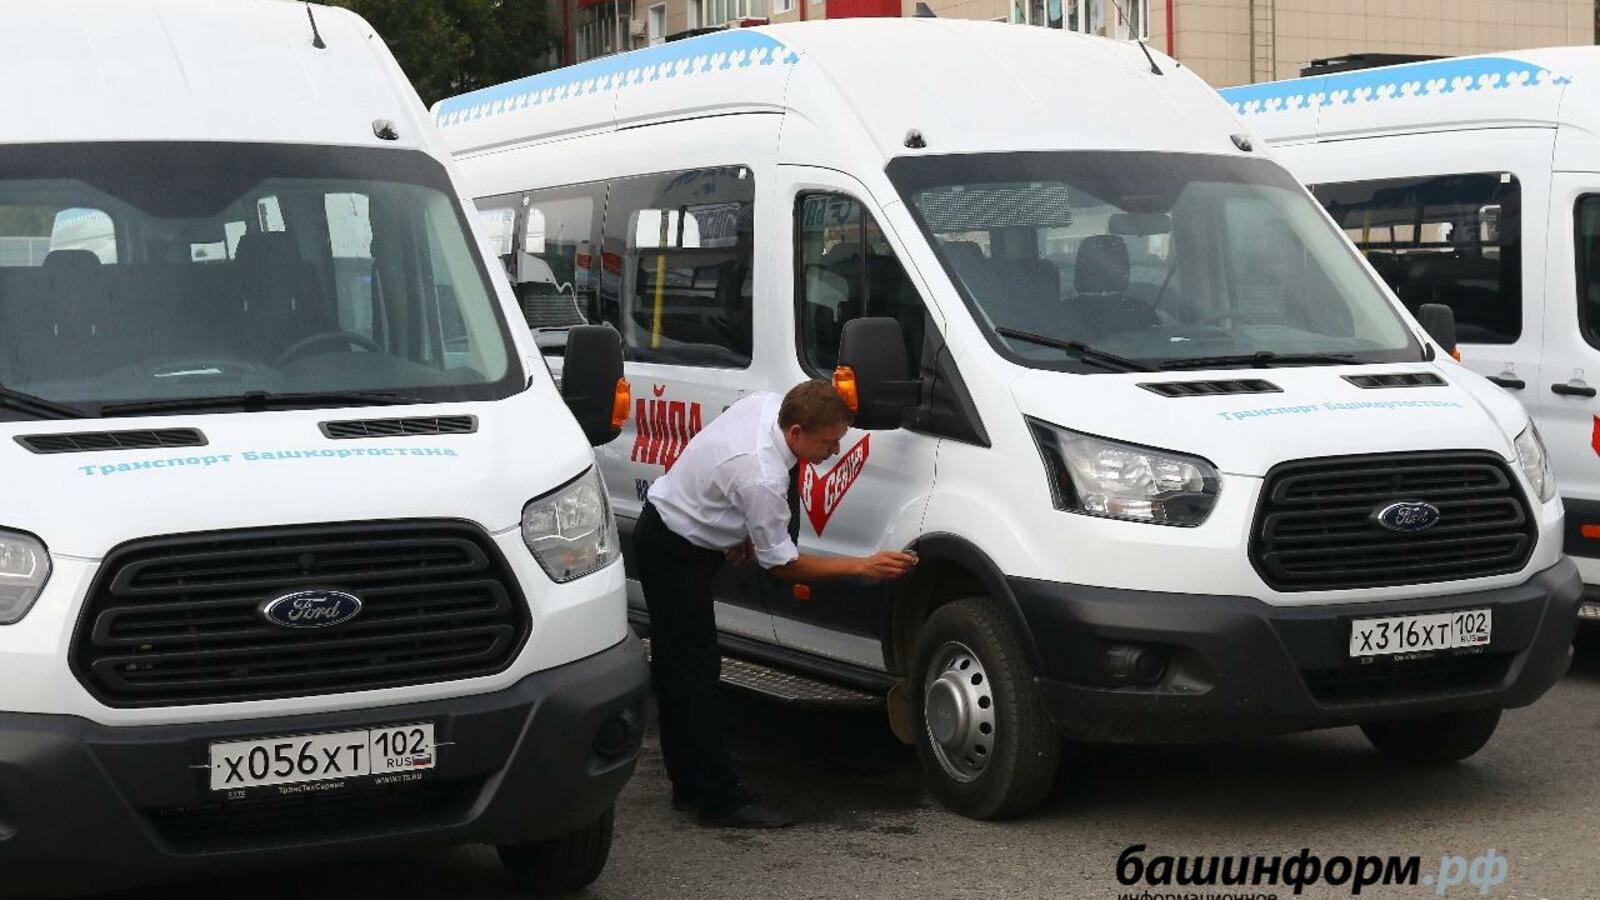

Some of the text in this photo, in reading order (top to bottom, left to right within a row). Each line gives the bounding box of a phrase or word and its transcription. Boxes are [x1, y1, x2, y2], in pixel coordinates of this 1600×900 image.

[1217, 403, 1319, 421] Транспорт
[78, 447, 459, 476] Транспорт Башкортостана
[288, 597, 341, 621] Ford
[1360, 612, 1486, 652] Х316ХТ 102
[1460, 634, 1476, 643] RUS
[225, 728, 425, 783] Х056ХТ 102
[387, 756, 412, 768] RUS
